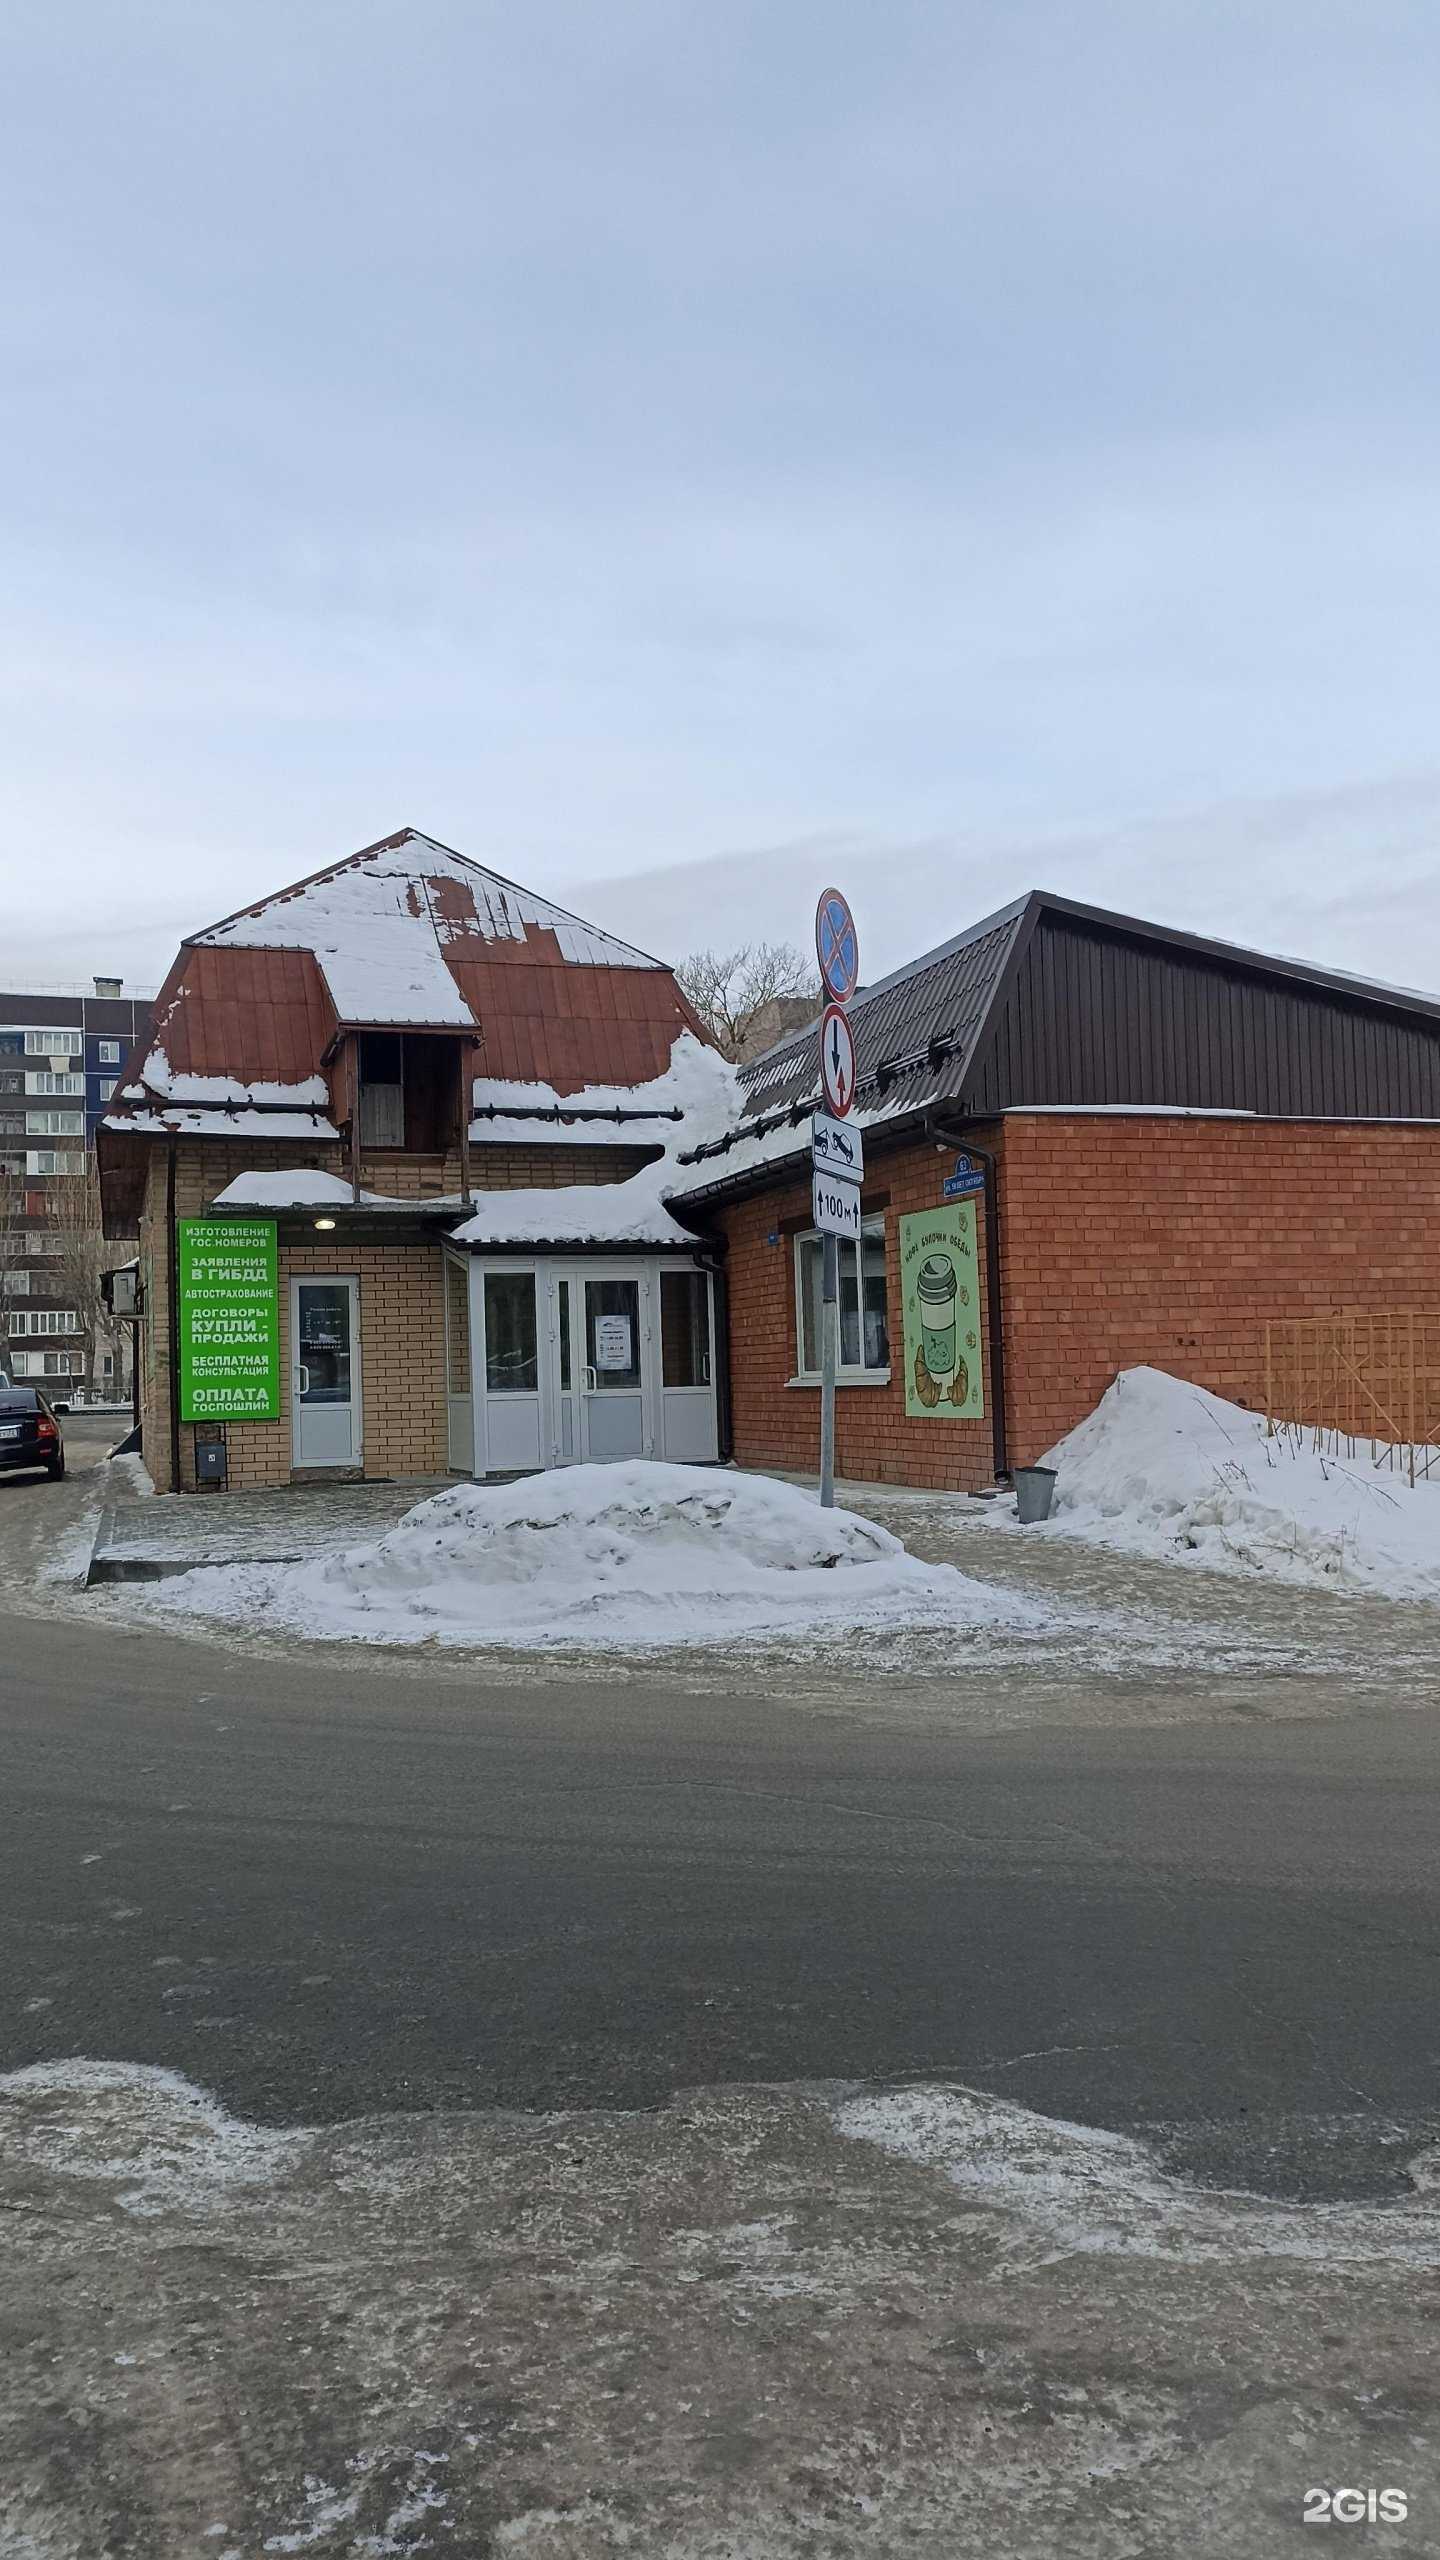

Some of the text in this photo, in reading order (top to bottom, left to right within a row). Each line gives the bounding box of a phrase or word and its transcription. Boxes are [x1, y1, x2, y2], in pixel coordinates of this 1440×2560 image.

[186, 1227, 271, 1237] ИЗГОТОВЛЕНИЕ
[921, 1232, 947, 1248] БУЛОЧКИ
[949, 1235, 971, 1258] ОБЕДЫ
[191, 1257, 267, 1267] ЗАЯВЛЕНИЯ
[191, 1268, 268, 1282] В ГИБДД
[185, 1289, 274, 1299] АВТОСТРАХОВАНИЕ
[191, 1308, 268, 1318] ДОГОВОРЫ
[191, 1320, 257, 1332] КУПЛИ
[191, 1333, 269, 1345] ПРОДАЖИ
[192, 1355, 269, 1367] БЕСПЛАТНАЯ
[192, 1366, 269, 1377] КОНСУЛЬТАЦИЯ
[192, 1388, 269, 1402] ОПЛАТА
[192, 1401, 270, 1413] ГОСПОШЛИН
